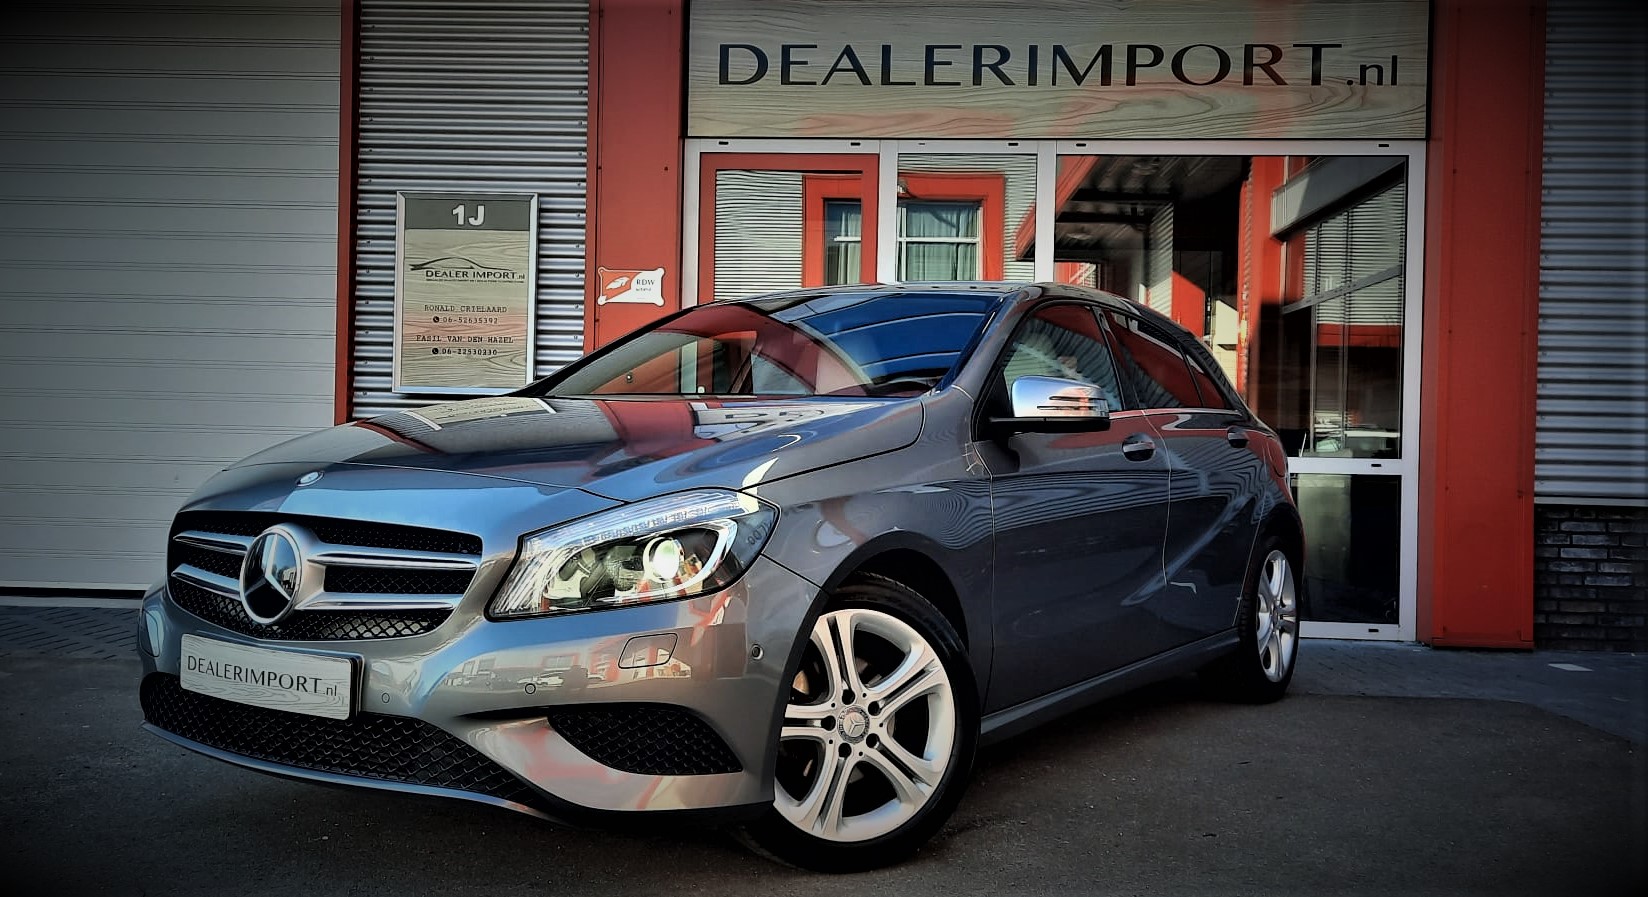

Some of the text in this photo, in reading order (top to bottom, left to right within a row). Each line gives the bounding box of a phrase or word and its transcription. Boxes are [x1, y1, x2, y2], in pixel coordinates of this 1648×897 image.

[718, 44, 1398, 87] DEALERIMPORT.nl
[452, 204, 485, 226] 1J
[426, 270, 469, 278] DEALER
[636, 278, 655, 286] RDW
[424, 304, 455, 312] RONALD
[187, 655, 337, 697] DEALERIMPORT.nl
